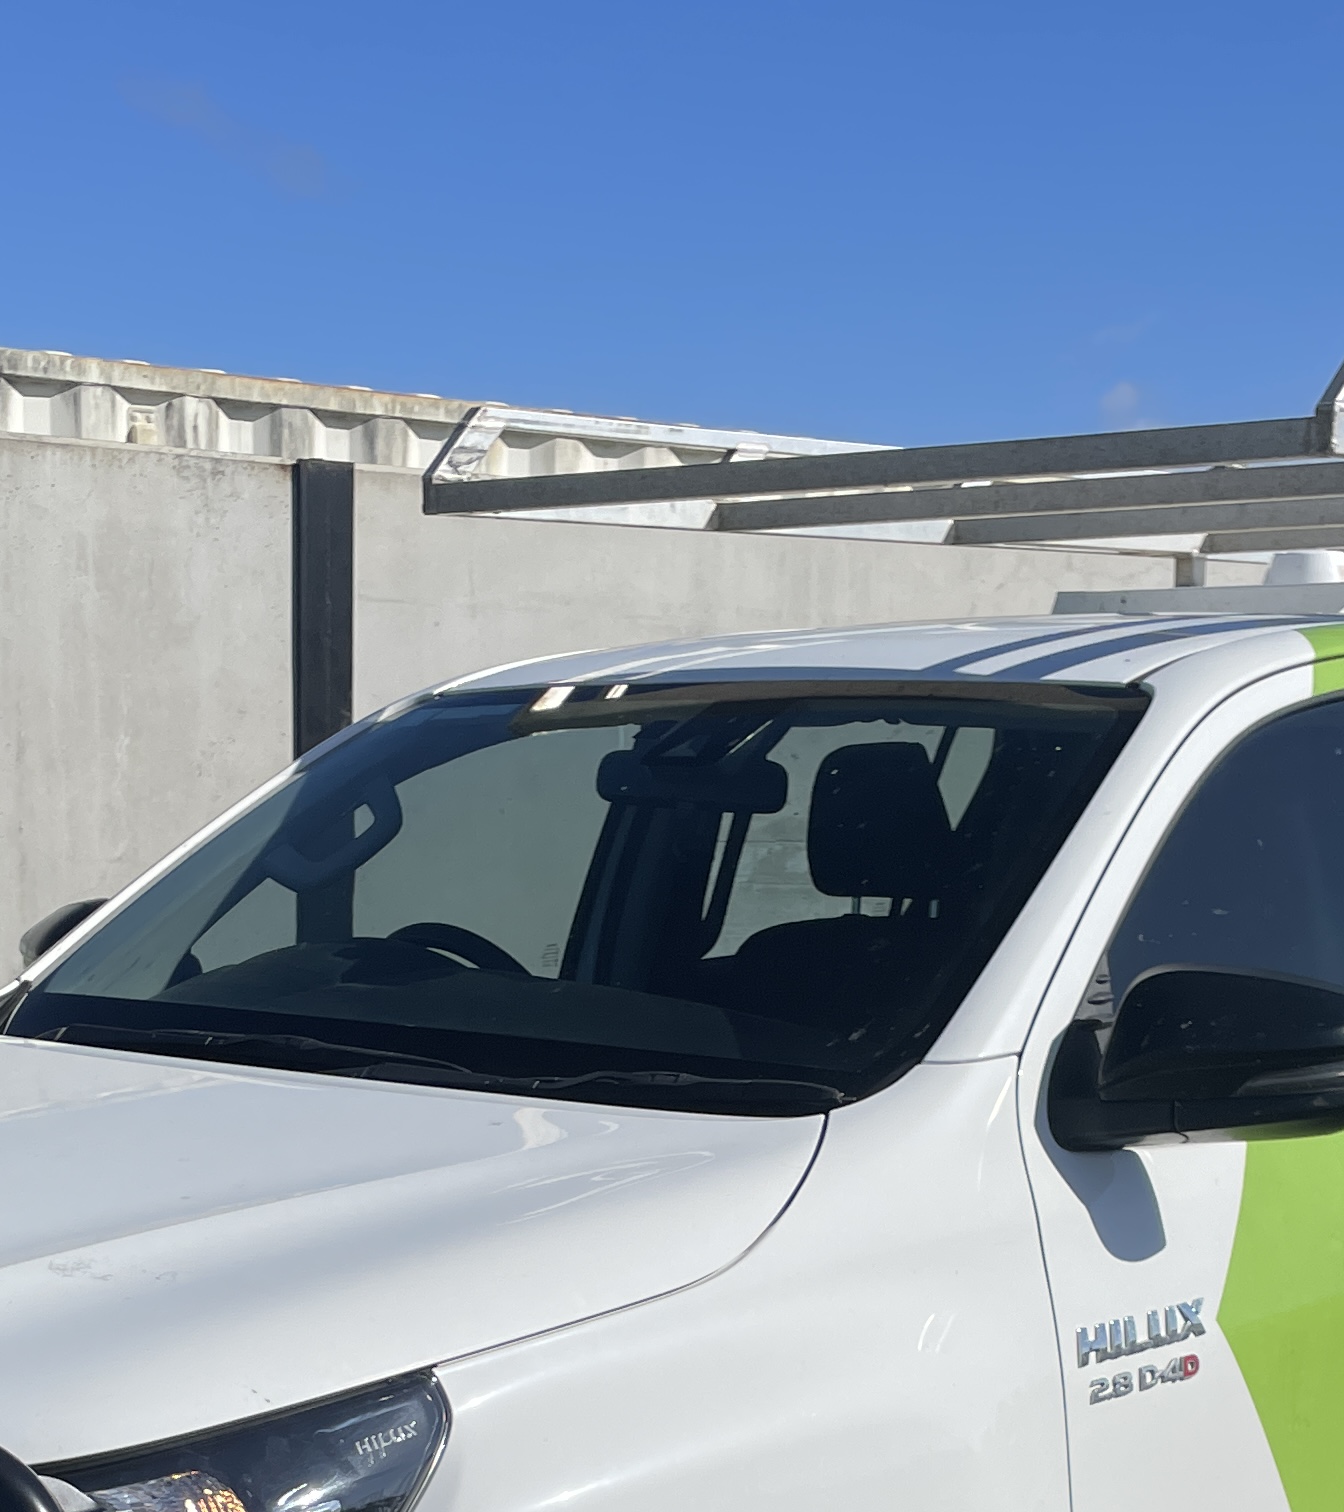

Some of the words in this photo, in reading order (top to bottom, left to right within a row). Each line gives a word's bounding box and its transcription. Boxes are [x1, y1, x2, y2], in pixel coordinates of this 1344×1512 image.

[1075, 1297, 1207, 1368] HILUX
[1138, 1353, 1200, 1393] D-4D
[355, 1420, 419, 1456] HILUX
